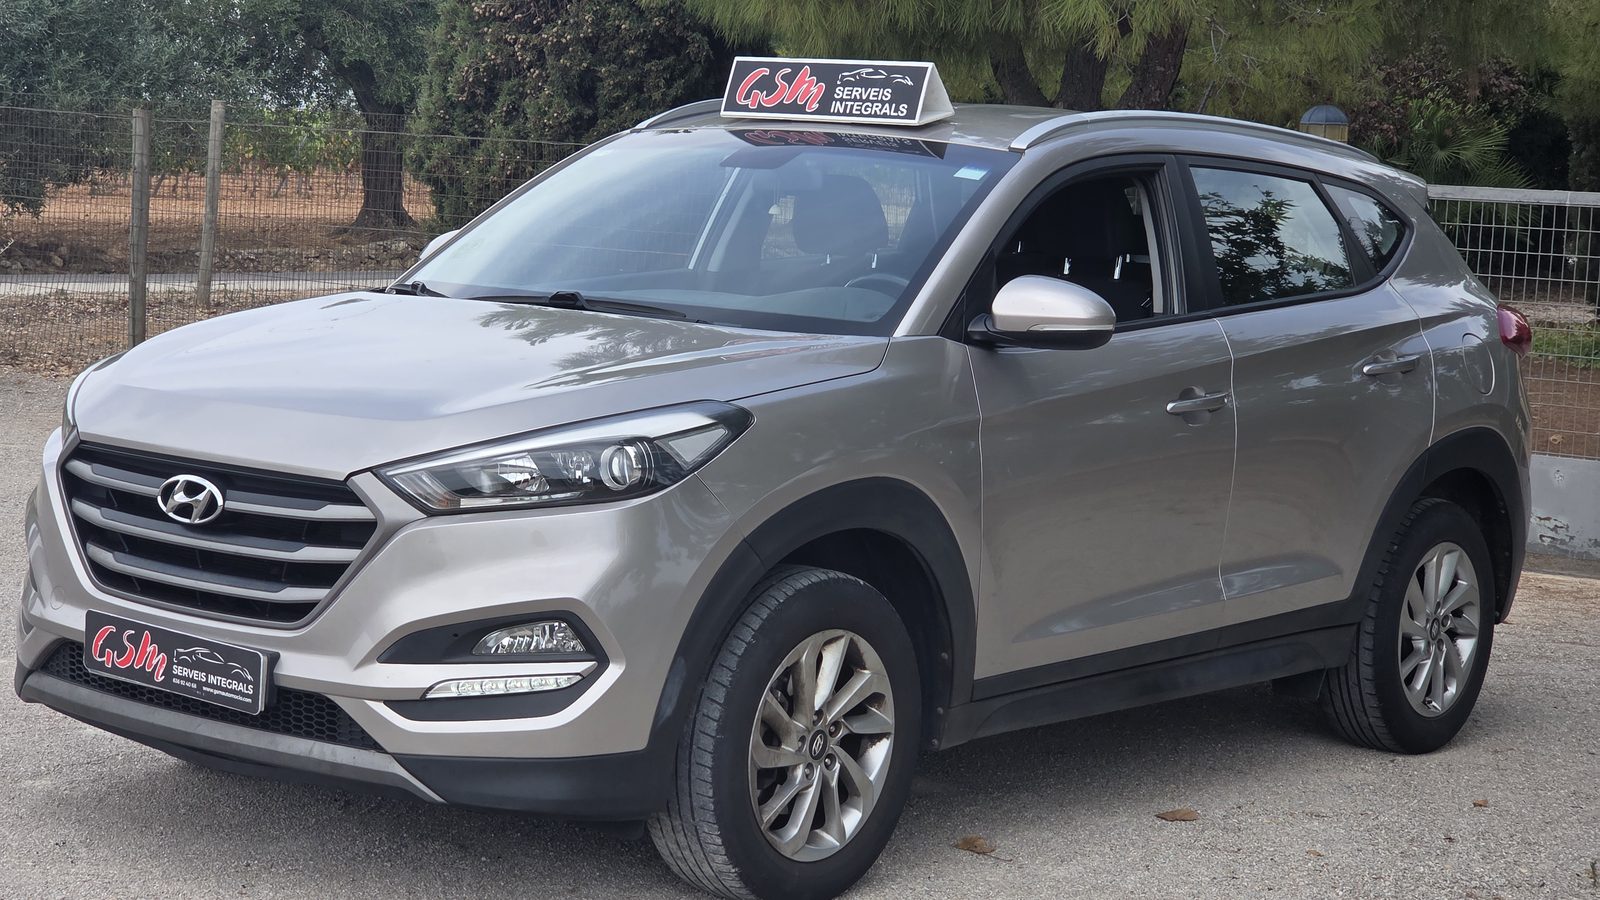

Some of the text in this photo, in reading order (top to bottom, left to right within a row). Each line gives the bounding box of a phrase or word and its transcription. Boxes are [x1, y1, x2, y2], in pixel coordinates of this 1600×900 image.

[834, 86, 892, 101] SERVEIS
[830, 100, 908, 117] INTEGRALS
[172, 664, 254, 695] SERVEIS INTEGRALS
